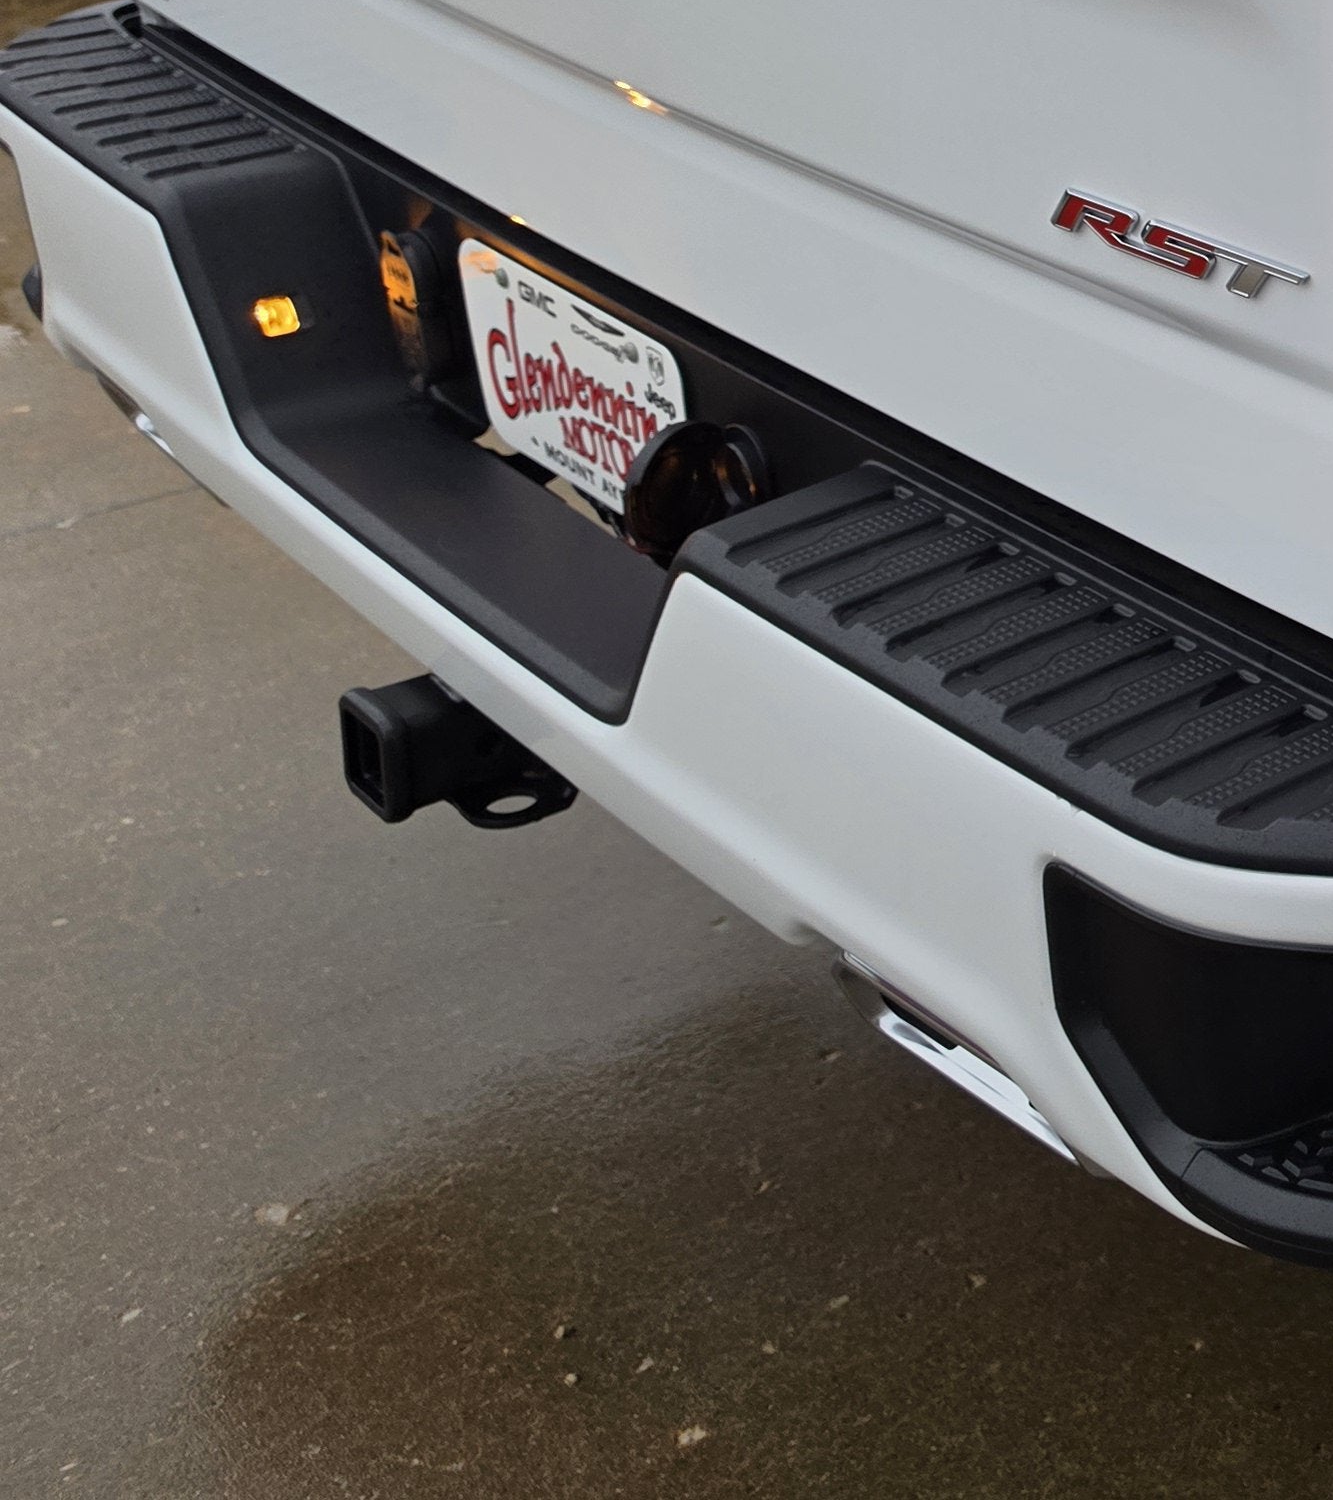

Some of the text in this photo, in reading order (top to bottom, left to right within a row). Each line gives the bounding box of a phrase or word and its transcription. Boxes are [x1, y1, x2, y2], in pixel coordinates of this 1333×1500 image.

[1050, 187, 1311, 298] RST
[517, 280, 557, 318] GMC
[487, 297, 658, 444] Glendennin
[543, 441, 625, 500] MOUNT AY
[559, 416, 637, 483] MOTO
